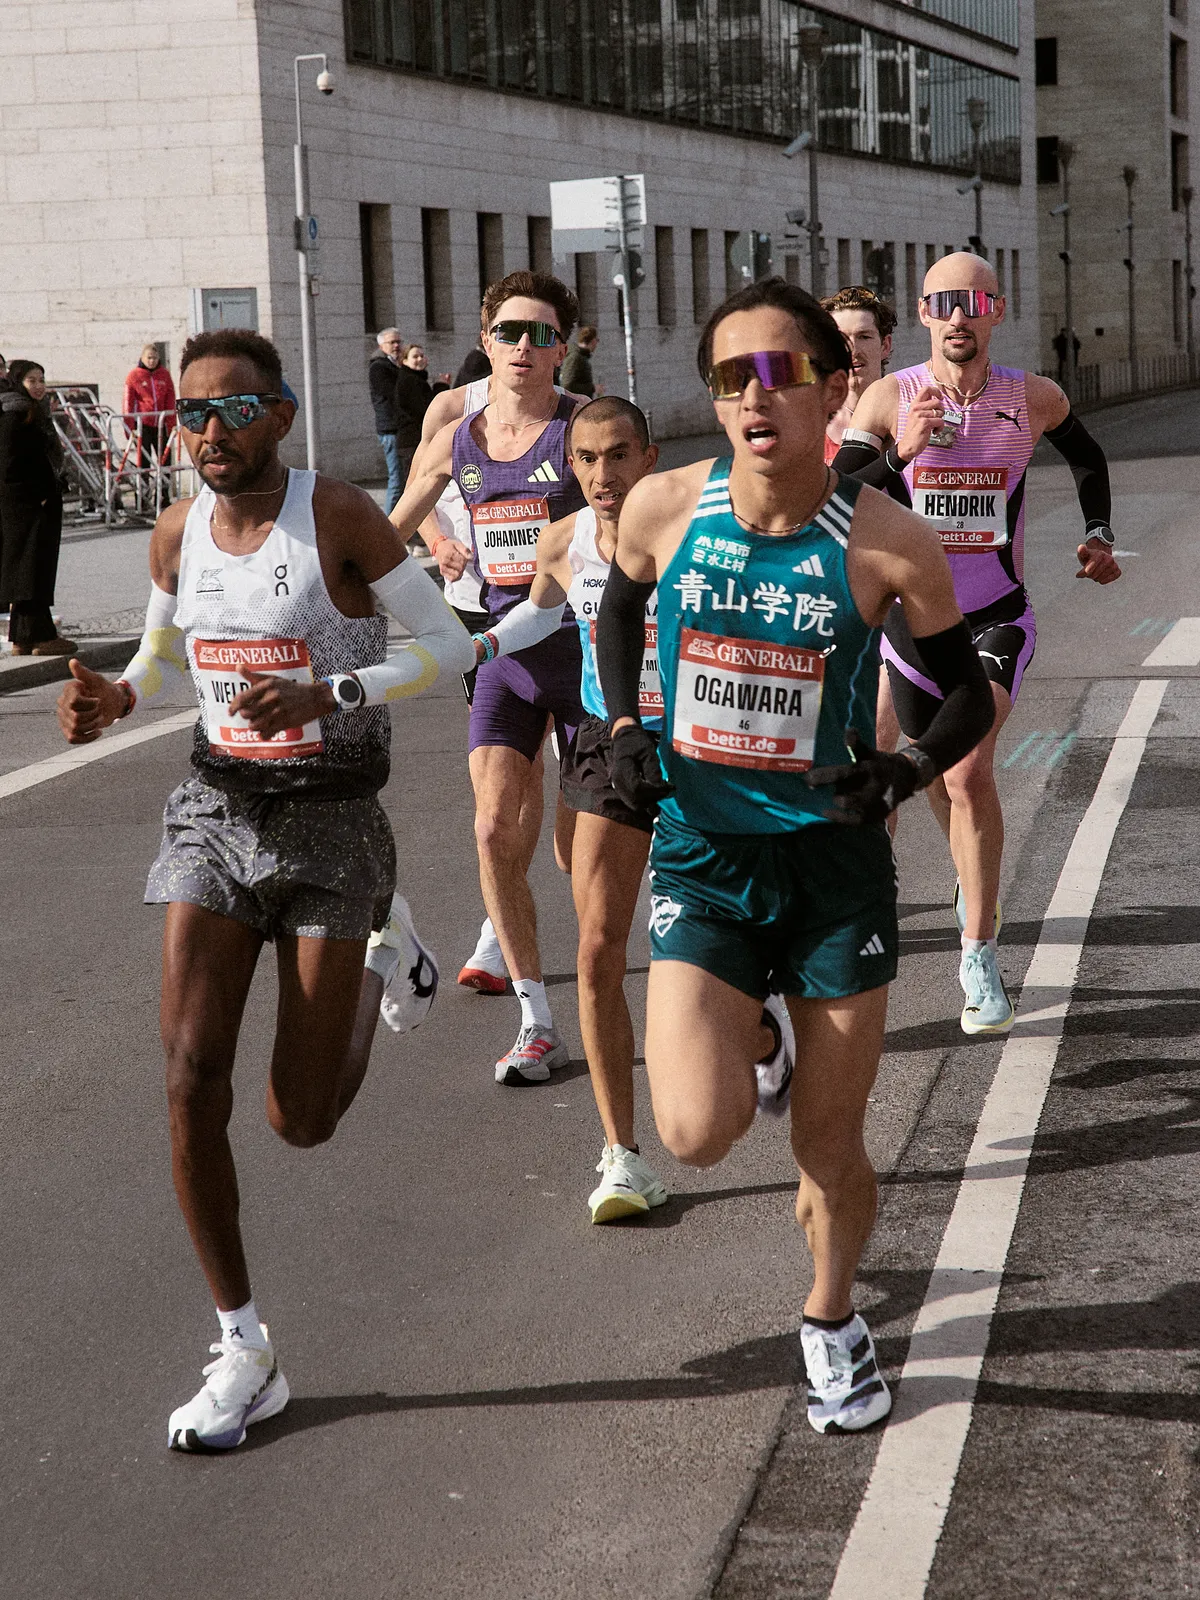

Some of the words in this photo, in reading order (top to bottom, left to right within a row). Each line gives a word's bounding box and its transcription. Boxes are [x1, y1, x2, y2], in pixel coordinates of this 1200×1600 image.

[938, 472, 1001, 486] GENERALI
[490, 502, 543, 519] GENERALI
[924, 493, 996, 517] HENDRIK
[956, 520, 964, 529] 28
[484, 527, 541, 548] JOHANNES
[495, 563, 533, 574] bett1.de
[707, 554, 746, 573] 水上村
[673, 568, 838, 637] 青山学院
[218, 644, 300, 665] GENERALI
[717, 643, 814, 674] GENERALI
[694, 674, 803, 717] OGAWARA
[738, 719, 751, 731] 46
[707, 731, 778, 753] bett1.de
